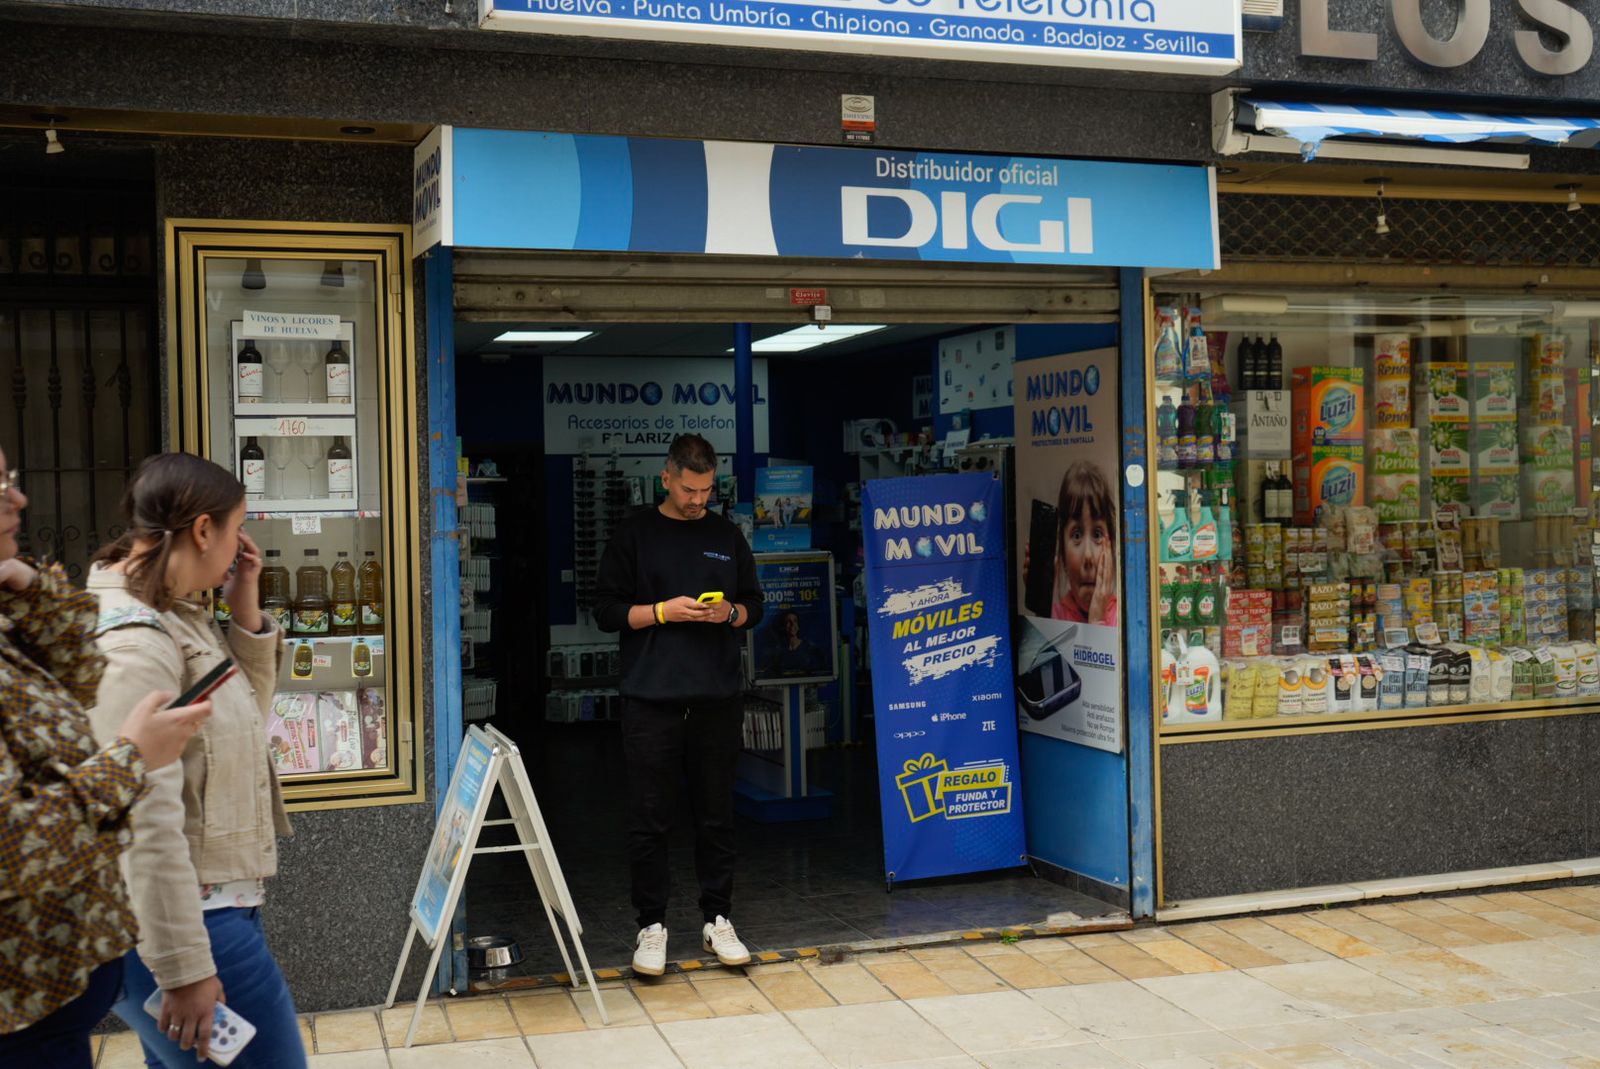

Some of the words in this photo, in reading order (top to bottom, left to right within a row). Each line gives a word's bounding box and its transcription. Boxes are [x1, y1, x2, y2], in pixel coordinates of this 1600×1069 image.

[957, 0, 1156, 22] eeonía
[633, 0, 701, 20] Punta
[709, 3, 791, 27] Umbría
[811, 10, 910, 35] Chipiona
[929, 18, 1025, 42] Granada
[1043, 26, 1126, 51] Badajoz
[1143, 32, 1210, 54] Sevilla
[415, 145, 442, 192] MUNDO
[875, 156, 993, 183] Distribuidor
[998, 163, 1059, 186] oficial
[841, 185, 1094, 254] DIGI
[250, 313, 280, 324] VINOS
[292, 316, 335, 325] LICORES
[264, 325, 276, 333] DE
[281, 326, 320, 336] HUELVA
[547, 381, 663, 406] MUNDO
[671, 381, 766, 406] MOVL
[1026, 364, 1100, 402] MUNDO
[1319, 394, 1356, 422] Luzil
[567, 414, 650, 430] Accesorios
[655, 414, 675, 429] de
[679, 414, 735, 430] Telefon
[1031, 404, 1093, 437] MOVIL
[602, 432, 704, 444] PLARIZA
[1320, 472, 1356, 501] Luzil
[873, 500, 989, 530] MUNDO
[884, 532, 985, 561] MOVIL
[909, 600, 918, 608] Y
[917, 591, 951, 607] AHORA
[892, 600, 985, 640] MÓVILES
[903, 640, 923, 654] AL
[925, 625, 977, 649] MEJOR
[922, 644, 977, 668] PRECIO
[1073, 648, 1116, 667] HIDROGEL
[888, 700, 927, 711] SAMSUNG
[939, 711, 968, 722] iPhone
[982, 720, 997, 732] ZTE
[1086, 720, 1093, 729] No
[943, 770, 998, 788] REGALO
[948, 799, 1006, 815] PROTECTOR
[955, 790, 988, 803] FUNDA
[990, 789, 999, 799] Y
